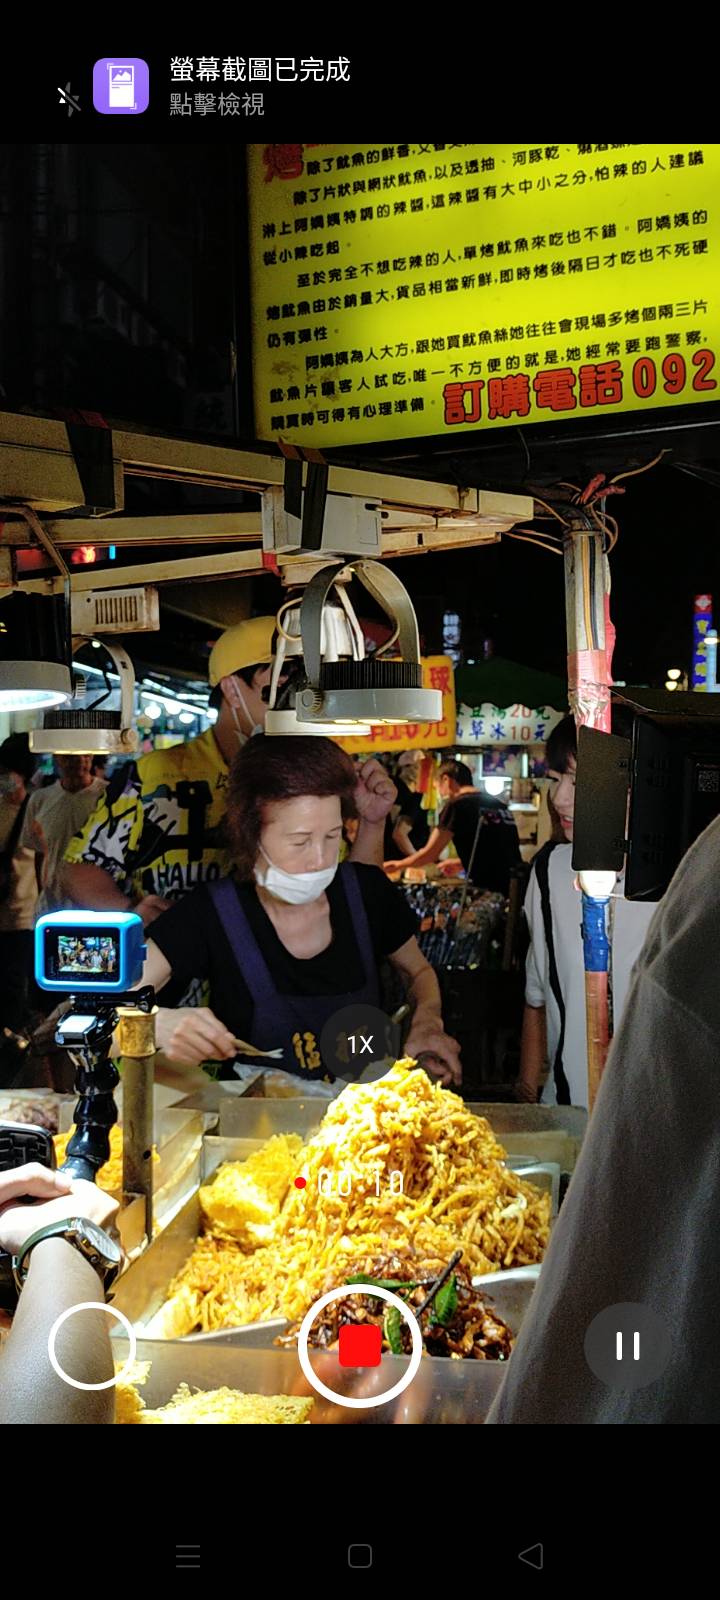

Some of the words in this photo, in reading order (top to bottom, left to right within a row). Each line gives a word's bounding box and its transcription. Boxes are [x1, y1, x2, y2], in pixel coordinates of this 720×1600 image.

[442, 360, 623, 425] 訂購電話
[632, 349, 717, 398] 092
